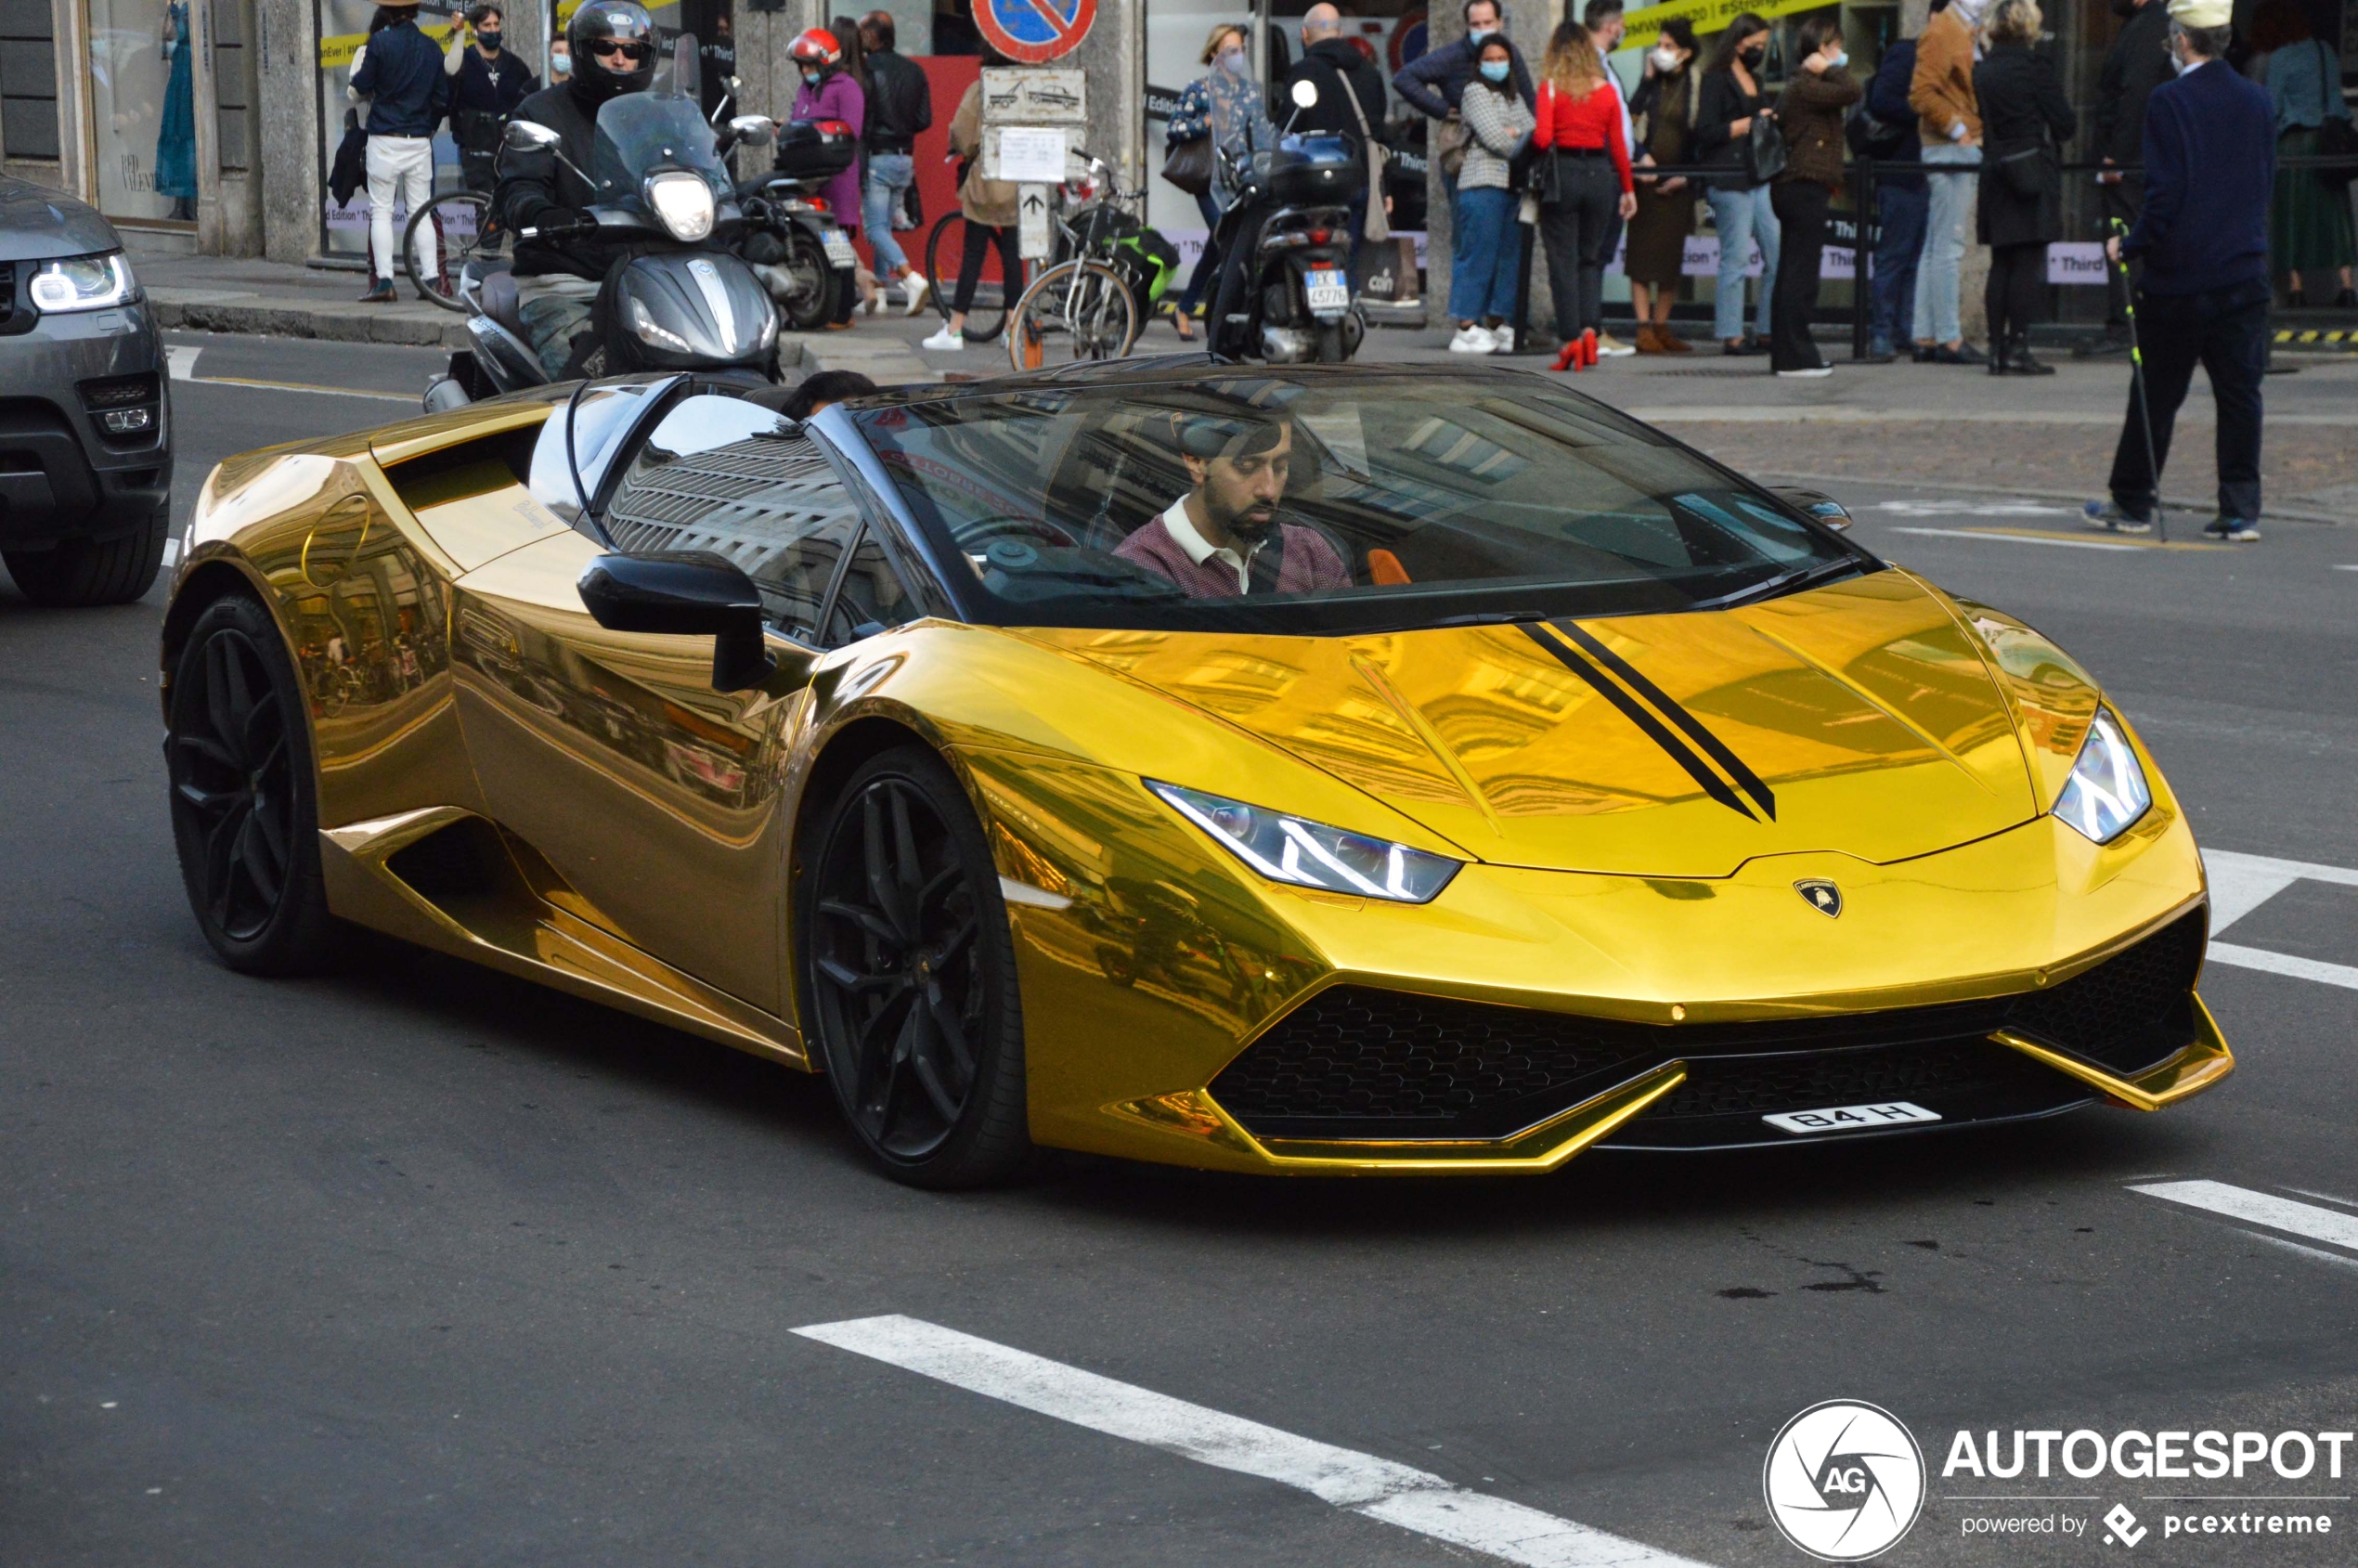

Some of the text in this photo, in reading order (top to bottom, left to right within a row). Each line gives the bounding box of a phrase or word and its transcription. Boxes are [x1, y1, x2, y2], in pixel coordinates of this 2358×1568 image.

[714, 45, 733, 61] Third
[331, 209, 356, 221] Edition
[2062, 255, 2105, 270] Third
